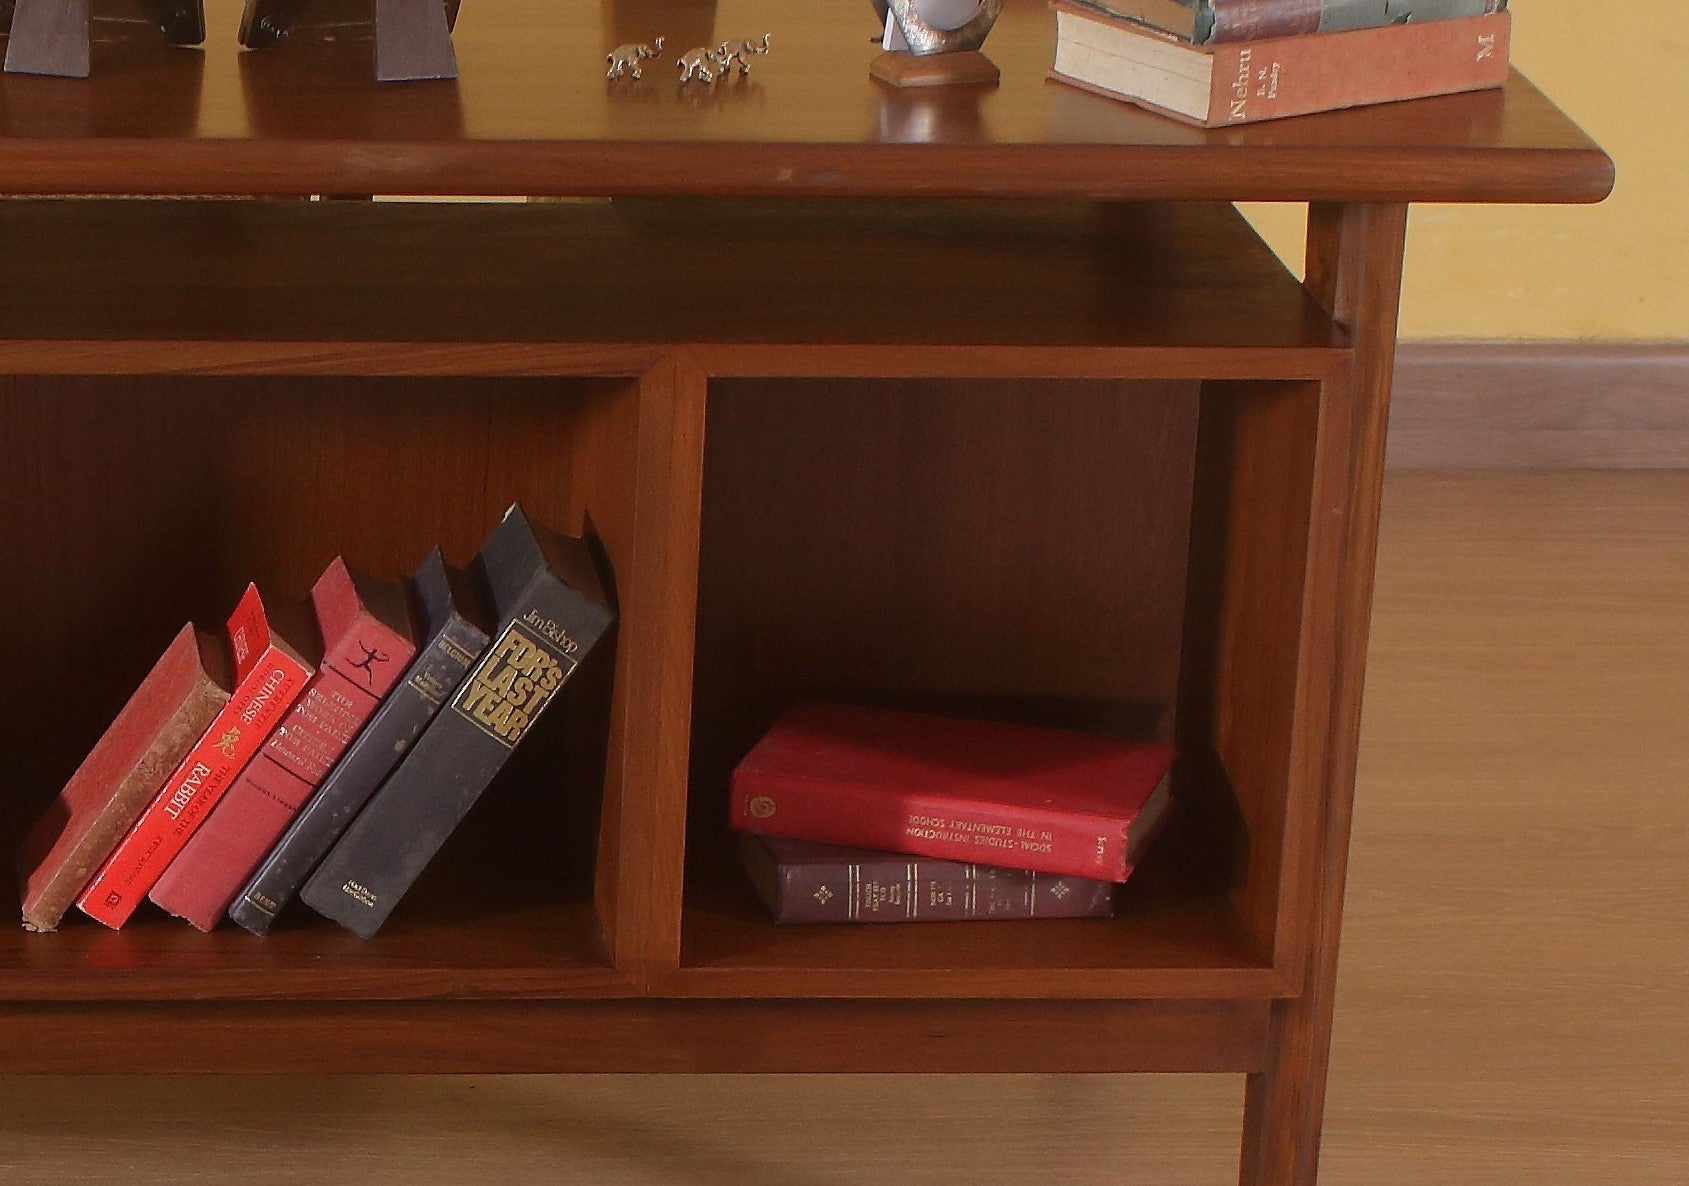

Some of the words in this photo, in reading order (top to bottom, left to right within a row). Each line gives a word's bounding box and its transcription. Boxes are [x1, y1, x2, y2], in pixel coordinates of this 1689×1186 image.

[1476, 34, 1494, 62] M
[1229, 48, 1252, 120] Nehru
[523, 608, 545, 630] Jim
[542, 619, 578, 654] Bishop
[477, 654, 550, 715] LAST
[494, 629, 563, 692] FDR'S
[241, 669, 285, 725] CHINESE
[462, 679, 529, 742] YEAR
[163, 761, 211, 821] RABBIT
[905, 827, 970, 844] INSTRUCTION
[908, 814, 945, 829] SCHOOL
[950, 820, 1013, 837] ELEMENTARY
[1016, 828, 1036, 840] THE
